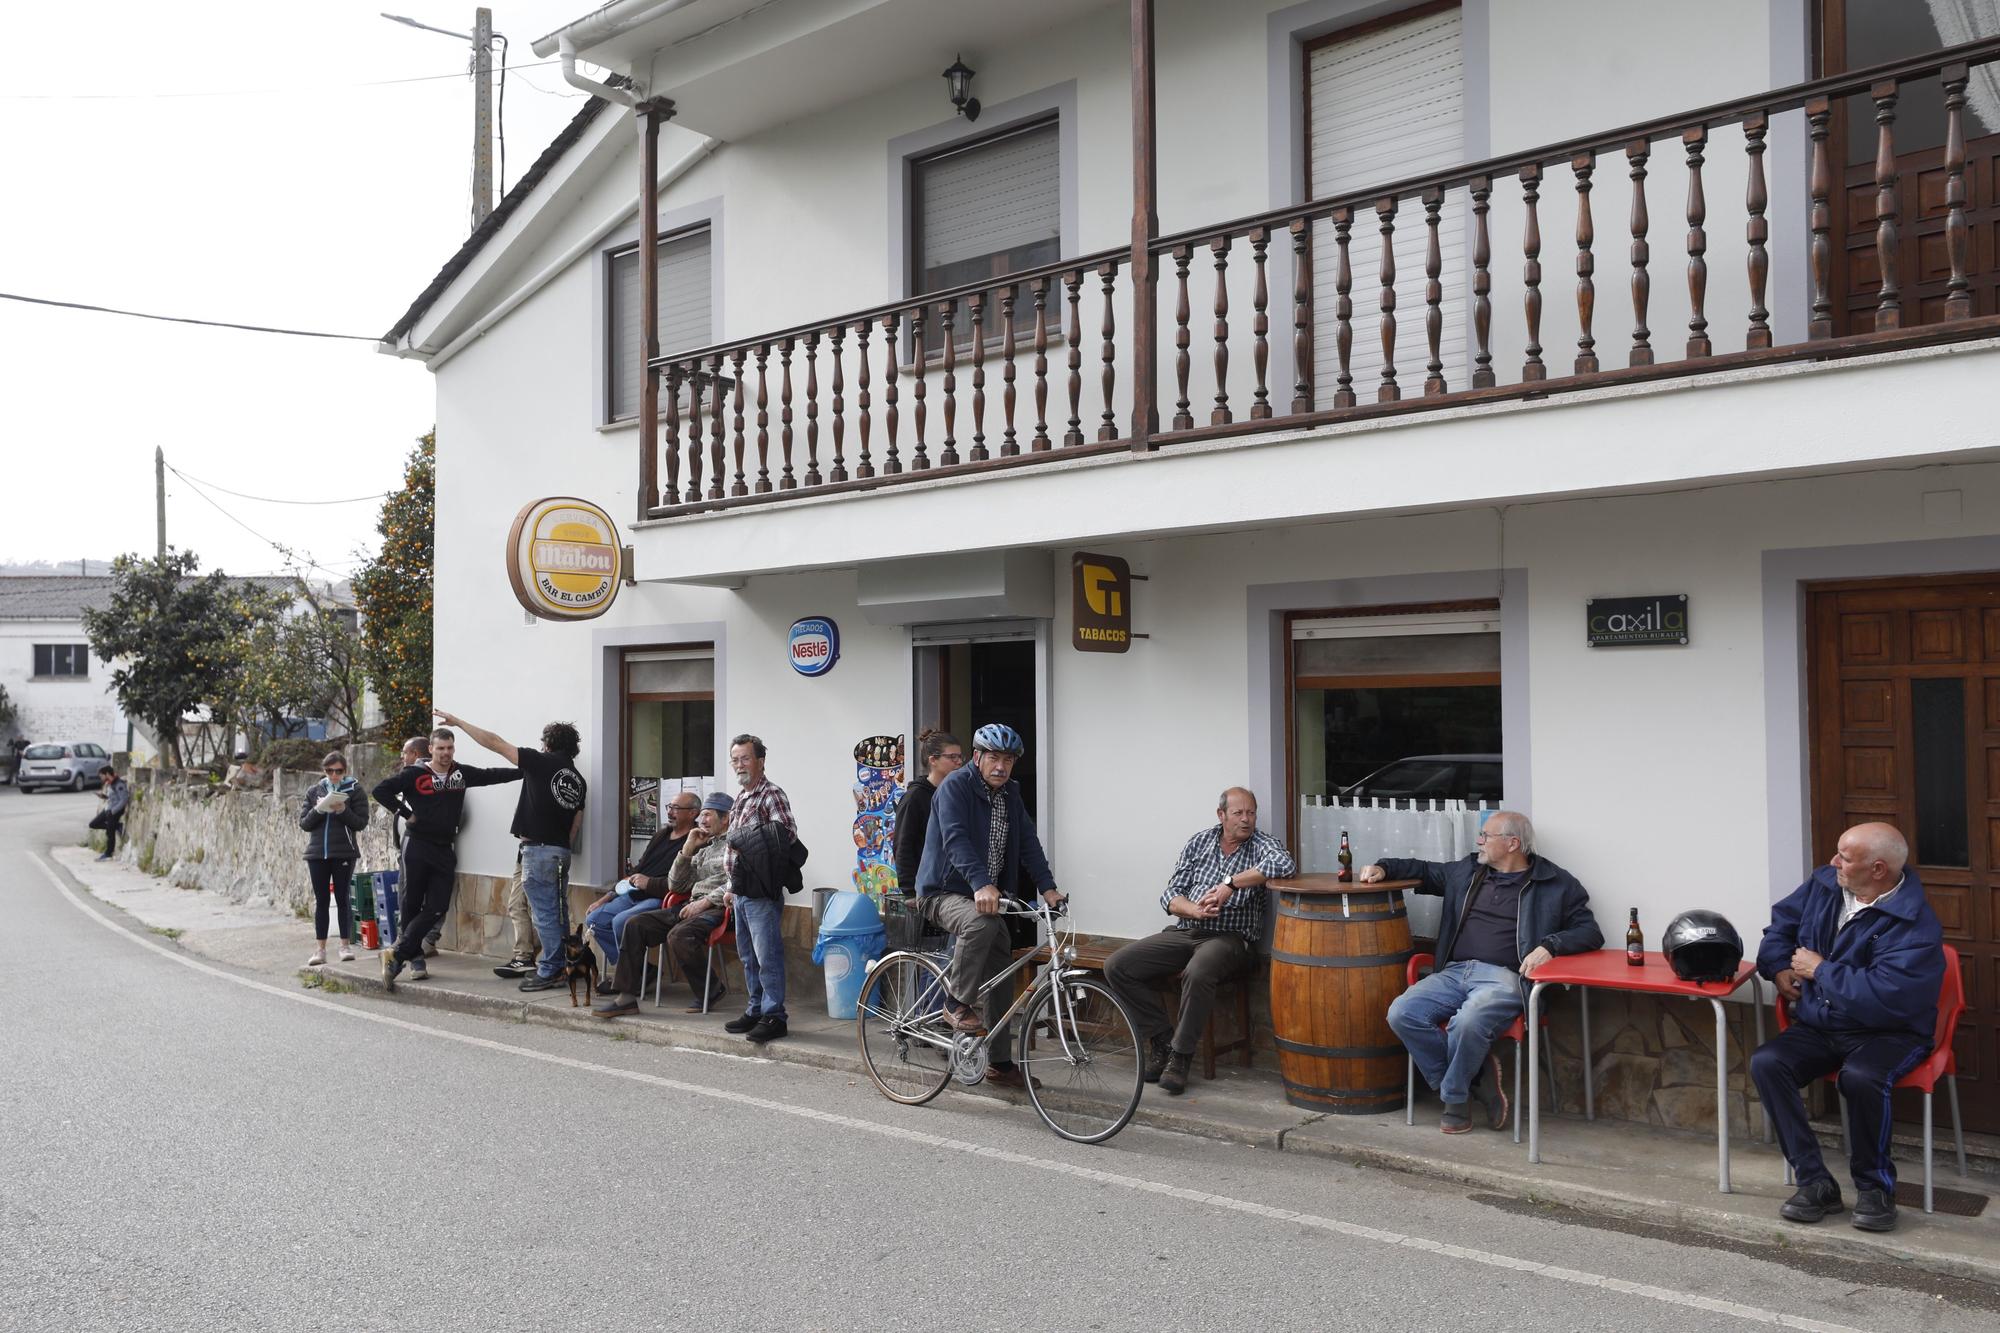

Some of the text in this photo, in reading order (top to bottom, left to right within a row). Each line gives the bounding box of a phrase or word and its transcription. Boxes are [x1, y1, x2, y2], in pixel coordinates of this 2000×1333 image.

[537, 543, 611, 570] Mahou
[541, 578, 608, 602] BAR EL CAMBIO
[795, 623, 824, 635] HELADOS
[1079, 627, 1126, 642] TABACOS
[1591, 630, 1685, 641] APARTAMENTOS RURALES
[792, 641, 828, 658] Nestlé
